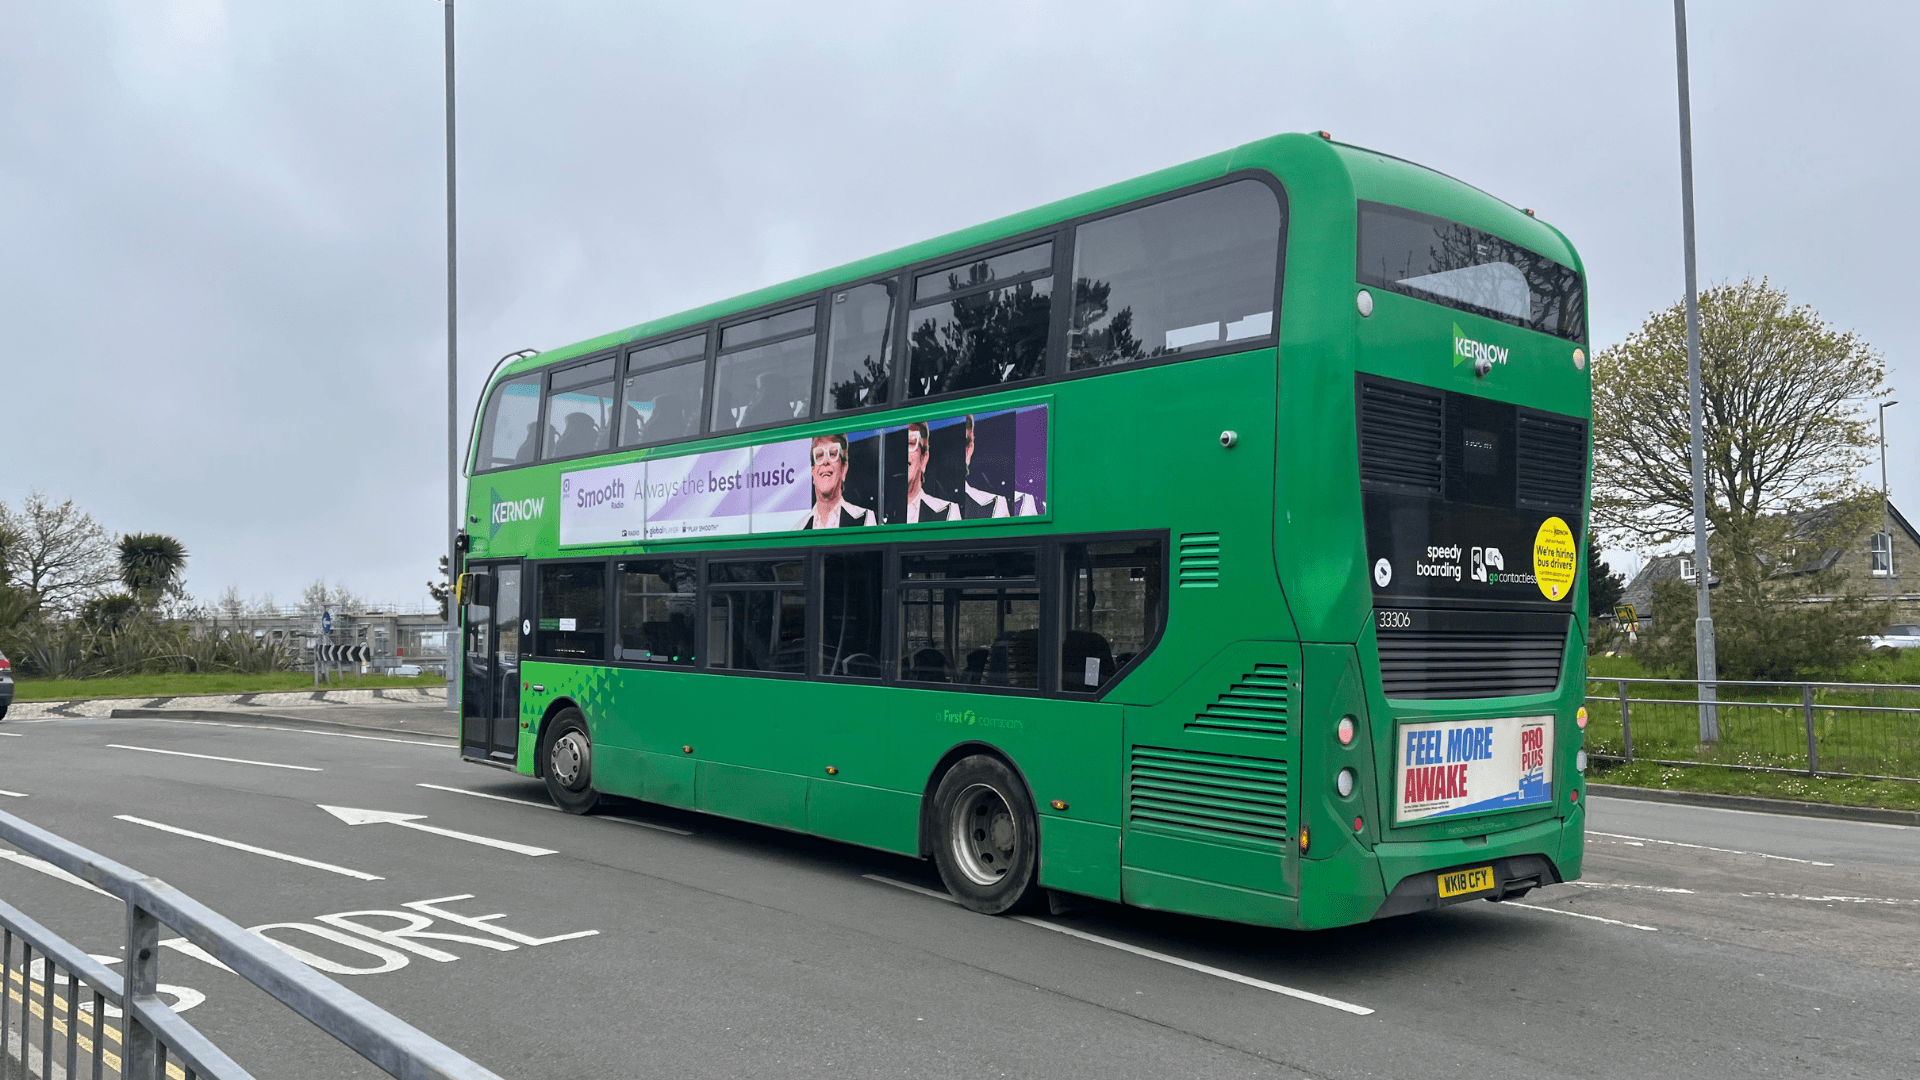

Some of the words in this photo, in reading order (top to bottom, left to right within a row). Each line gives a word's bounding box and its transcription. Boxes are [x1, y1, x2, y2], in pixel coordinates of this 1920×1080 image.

[1455, 336, 1509, 365] KERNOW
[577, 478, 624, 508] Smooth
[634, 479, 679, 504] Always
[682, 473, 705, 496] the
[708, 470, 742, 493] best
[746, 461, 795, 488] music
[492, 497, 544, 524] KERNOW
[611, 501, 624, 509] Radio
[1427, 543, 1462, 563] speedy
[1536, 545, 1555, 557] We're
[1556, 547, 1574, 562] hiring
[1537, 556, 1549, 568] bus
[1550, 558, 1573, 570] drivers
[1416, 560, 1462, 582] boarding
[1379, 611, 1411, 627] 33306
[944, 709, 963, 723] First
[1406, 730, 1443, 766] FEEL
[1446, 726, 1493, 763] MORE
[1521, 726, 1543, 753] PRO
[1521, 748, 1544, 772] PLUS
[1404, 764, 1468, 804] AWAKE
[1444, 873, 1467, 893] WK18
[1468, 869, 1487, 889] CFY
